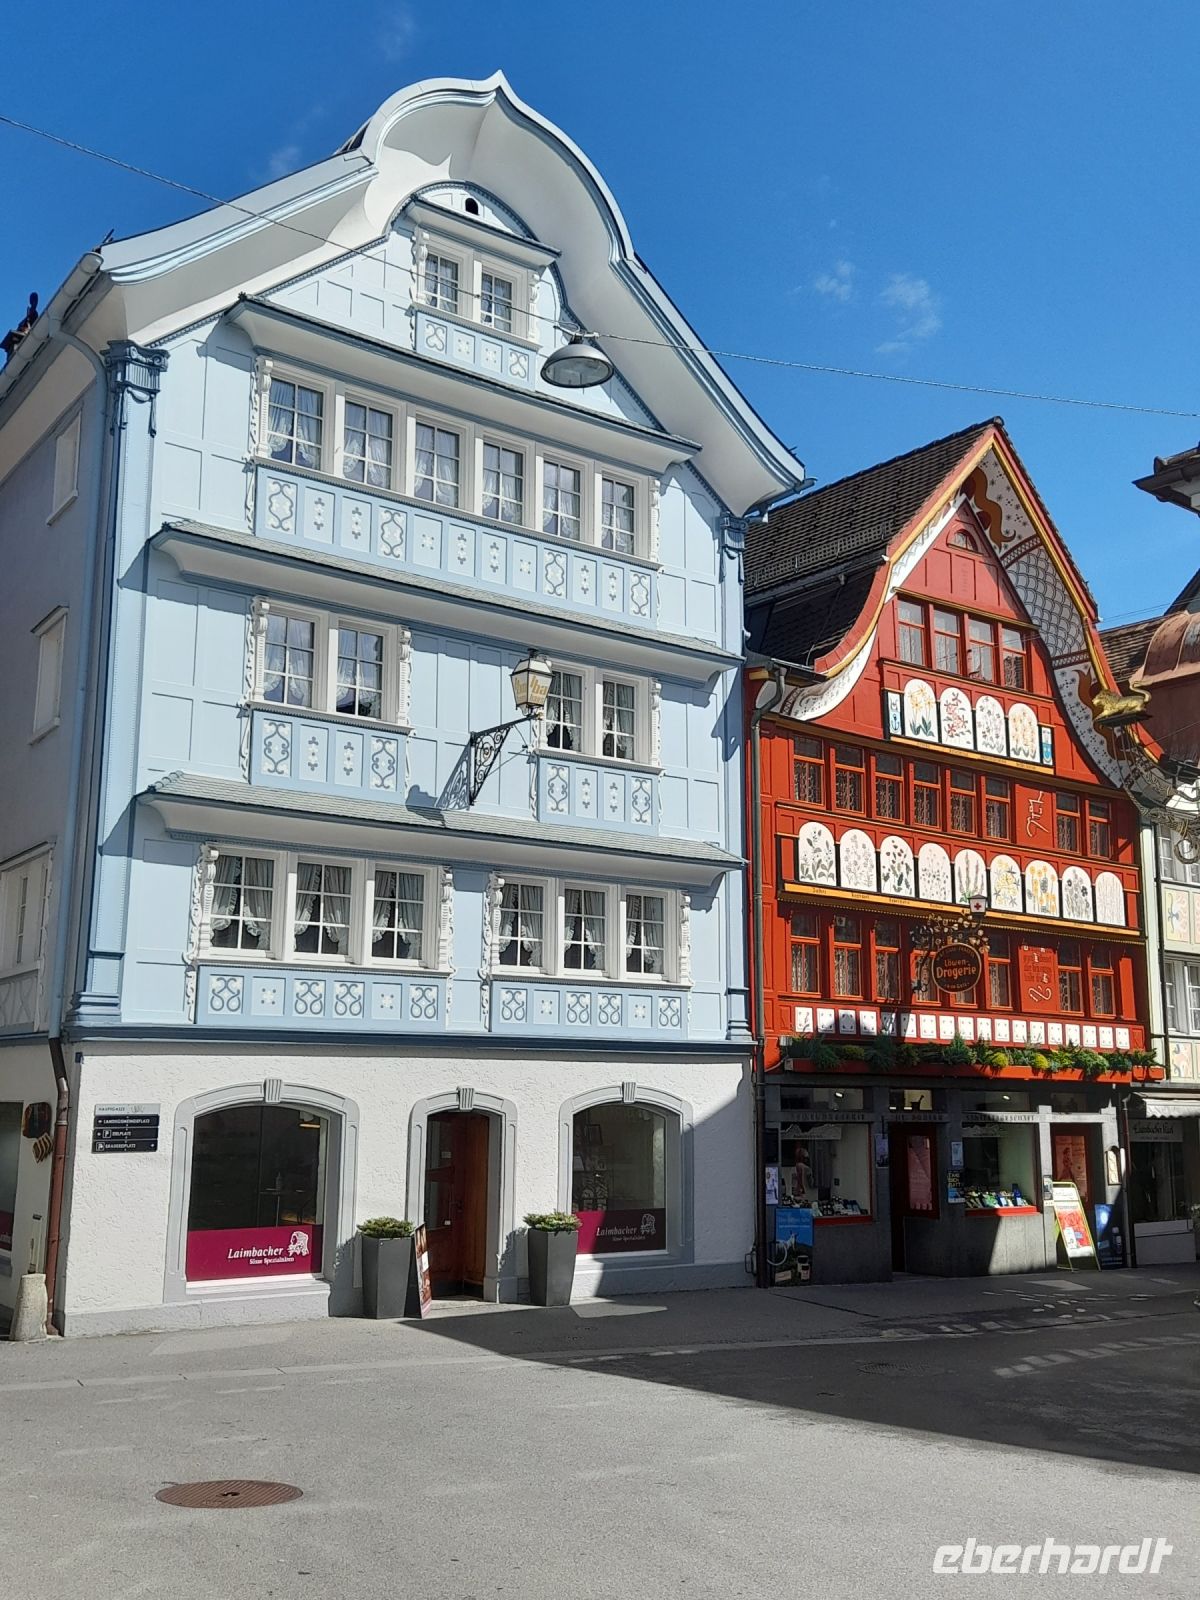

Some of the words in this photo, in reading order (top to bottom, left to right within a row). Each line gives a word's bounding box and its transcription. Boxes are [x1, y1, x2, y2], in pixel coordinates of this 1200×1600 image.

[944, 959, 970, 967] Löwen-
[936, 964, 977, 980] Drogerie
[596, 1226, 638, 1237] Laimbacher
[227, 1246, 284, 1259] Laimbacher
